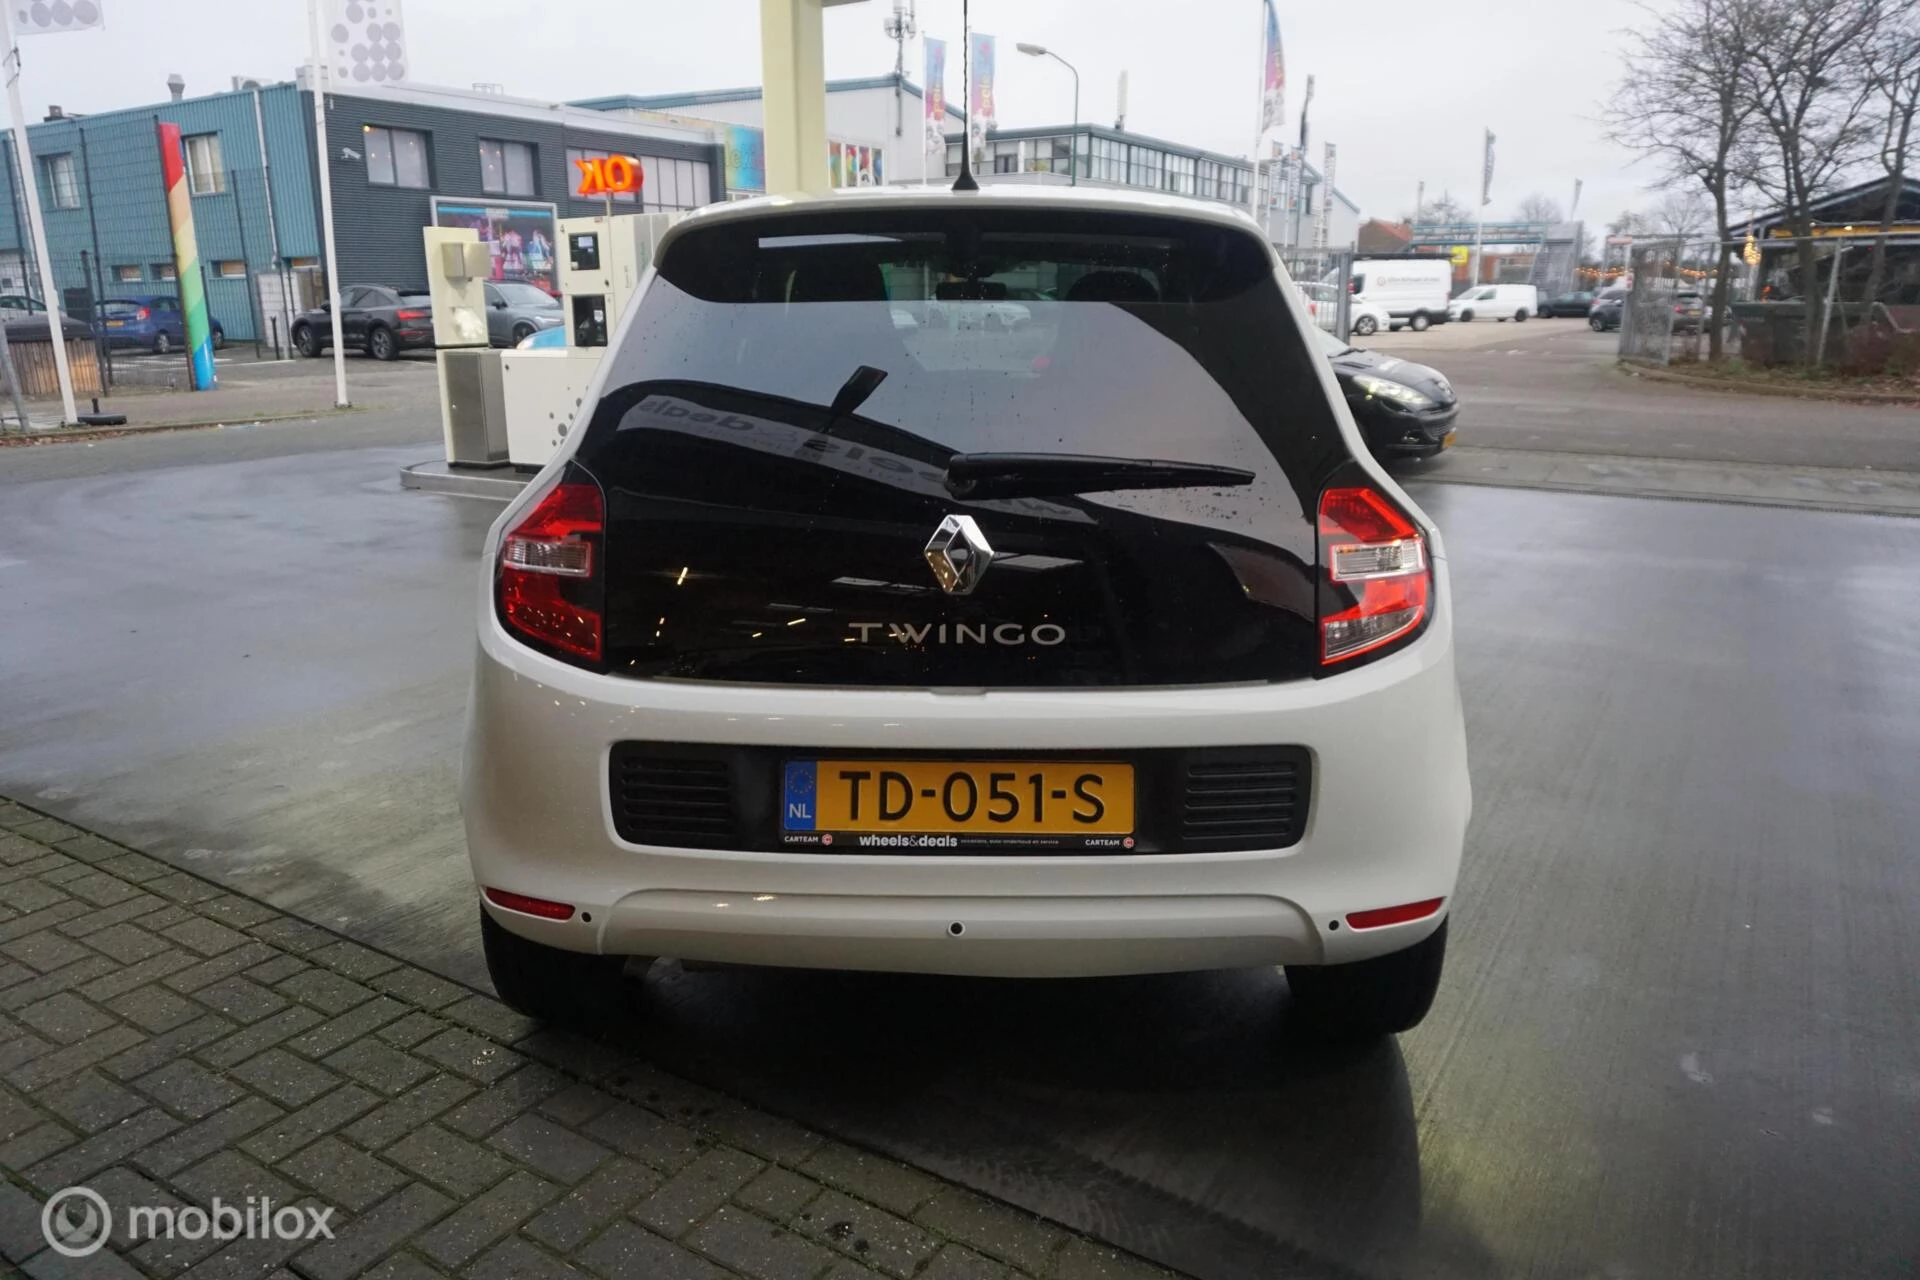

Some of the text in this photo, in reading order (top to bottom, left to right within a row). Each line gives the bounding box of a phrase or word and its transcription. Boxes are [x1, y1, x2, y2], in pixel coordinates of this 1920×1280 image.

[849, 623, 1066, 646] TWINGO
[839, 771, 1105, 823] TD-051-S
[789, 803, 811, 818] NL
[784, 835, 819, 843] CARTEAM
[859, 834, 958, 848] wheels&deals
[1085, 839, 1120, 847] CARTEAM
